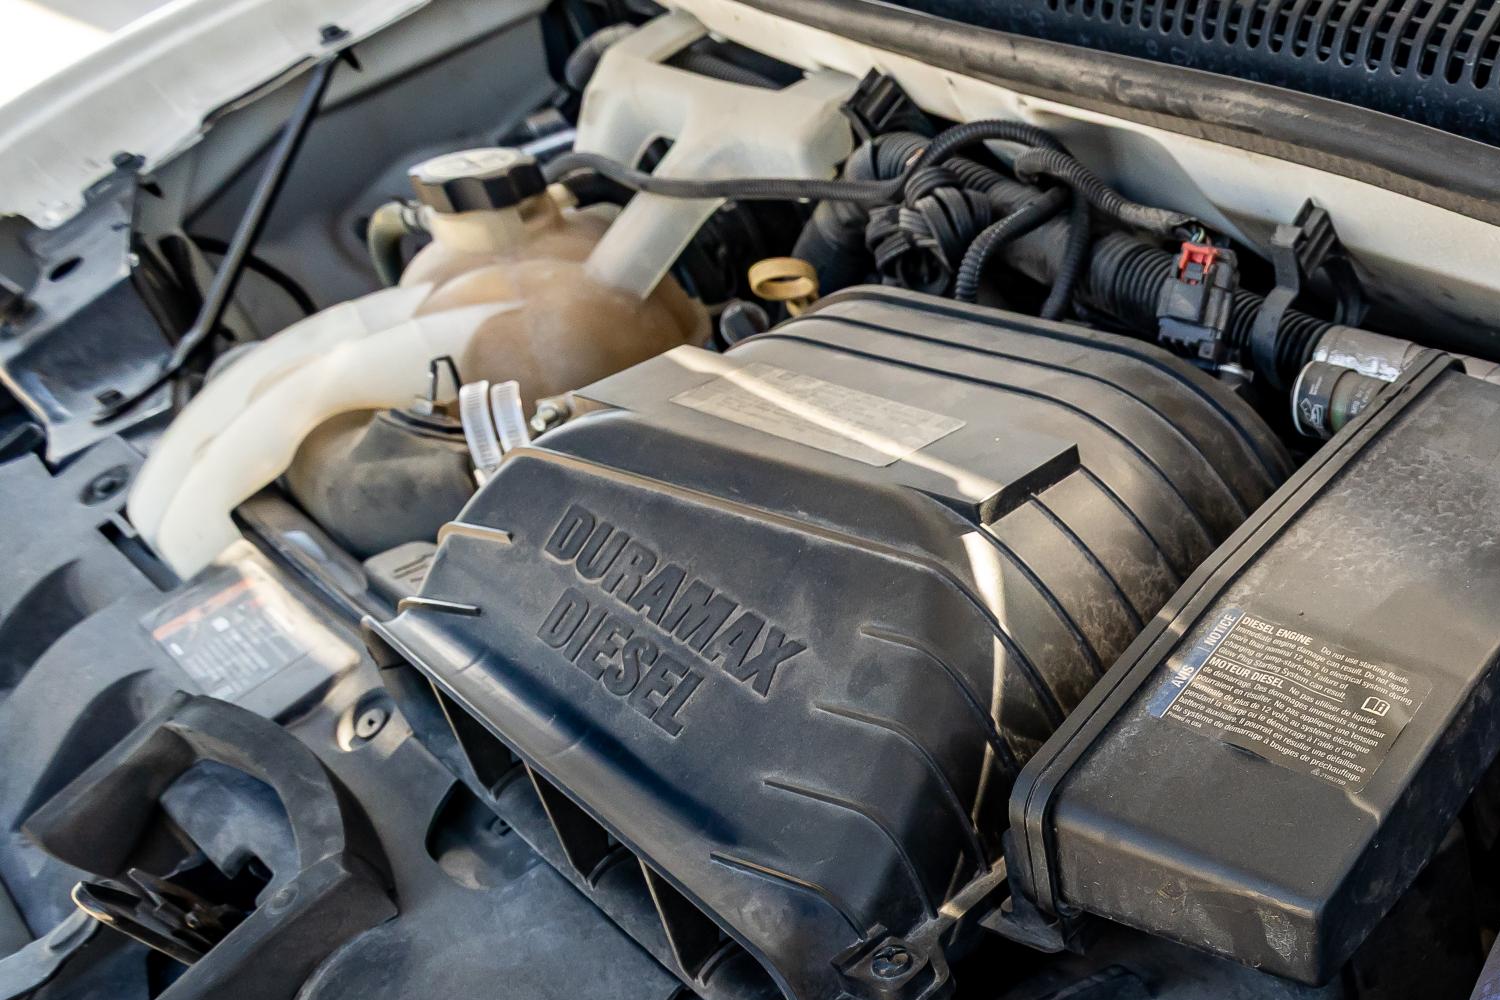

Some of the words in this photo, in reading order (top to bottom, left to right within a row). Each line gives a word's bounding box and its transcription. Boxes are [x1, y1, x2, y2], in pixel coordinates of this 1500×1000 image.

[544, 503, 807, 700] DURAMAX
[1203, 613, 1236, 646] NOTICE
[536, 586, 705, 738] DIESEL
[1169, 664, 1195, 688] AVIS
[1217, 646, 1237, 657] Glow
[1235, 653, 1254, 665] Plug
[1252, 659, 1281, 673] Starting
[1280, 667, 1310, 684] System
[1308, 681, 1324, 690] can
[1323, 685, 1348, 699] result.
[1223, 639, 1256, 655] charging
[1262, 653, 1315, 677] jump-starting.
[1312, 672, 1340, 686] Failure
[1229, 632, 1249, 643] more
[1248, 639, 1265, 649] than
[1264, 644, 1293, 657] nominal
[1292, 653, 1303, 661] 12
[1302, 657, 1321, 669] volts
[1320, 665, 1330, 673] to
[1328, 668, 1362, 685] electrical
[1360, 680, 1389, 695] system
[1386, 690, 1413, 705] during
[1235, 624, 1272, 643] Immediate
[1271, 637, 1297, 650] engine
[1295, 645, 1327, 663] damage
[1325, 659, 1341, 668] can
[1340, 663, 1364, 675] result.
[1363, 671, 1376, 679] Do
[1374, 676, 1388, 685] not
[1387, 681, 1410, 694] apply
[1240, 616, 1277, 635] DIESEL
[1275, 628, 1313, 645] ENGINE
[1319, 646, 1333, 655] Do
[1331, 651, 1345, 660] not
[1344, 655, 1359, 665] use
[1358, 660, 1388, 675] starting
[1386, 671, 1410, 684] fluids.
[1183, 688, 1214, 704] pendant
[1213, 699, 1223, 707] la
[1221, 702, 1248, 716] charge
[1264, 717, 1308, 740] démarrage
[1305, 734, 1314, 742] à
[1312, 737, 1335, 750] l'aide
[1333, 746, 1357, 759] d'une
[1189, 680, 1224, 698] nominale
[1223, 693, 1235, 701] de
[1232, 696, 1250, 708] plus
[1249, 701, 1260, 709] de
[1260, 705, 1272, 713] 12
[1269, 709, 1291, 722] volts
[1288, 719, 1301, 727] au
[1299, 722, 1333, 740] système
[1331, 734, 1371, 754] électrique
[1195, 673, 1234, 691] pourraient
[1232, 687, 1244, 695] en
[1243, 690, 1273, 704] résulter.
[1272, 700, 1286, 709] Ne
[1283, 706, 1300, 716] pas
[1298, 712, 1335, 731] appliquer
[1334, 726, 1350, 736] une
[1349, 731, 1379, 747] tension
[1202, 665, 1213, 673] de
[1211, 669, 1254, 689] démarrage.
[1253, 683, 1268, 692] Des
[1266, 687, 1309, 710] dommages
[1307, 705, 1348, 725] immédiats
[1346, 721, 1358, 729] au
[1357, 724, 1386, 739] moteur
[1208, 656, 1251, 678] MOTEUR
[1249, 671, 1286, 688] DIESEL
[1288, 686, 1301, 695] Ne
[1299, 693, 1315, 703] pas
[1314, 697, 1340, 712] utiliser
[1340, 707, 1352, 716] de
[1350, 711, 1378, 726] liquide
[1171, 703, 1183, 711] du
[1181, 707, 1214, 725] système
[1212, 719, 1224, 728] de
[1223, 723, 1264, 741] démarrage
[1262, 736, 1271, 744] à
[1267, 740, 1300, 758] bougies
[1298, 753, 1311, 762] de
[1308, 757, 1363, 783] préchauffage.
[1177, 695, 1206, 710] batterie
[1204, 706, 1239, 723] auxiliaire.
[1243, 719, 1273, 734] pourrait
[1271, 731, 1284, 740] en
[1282, 736, 1312, 752] résulter
[1310, 747, 1327, 757] une
[1325, 753, 1367, 773] défaillance
